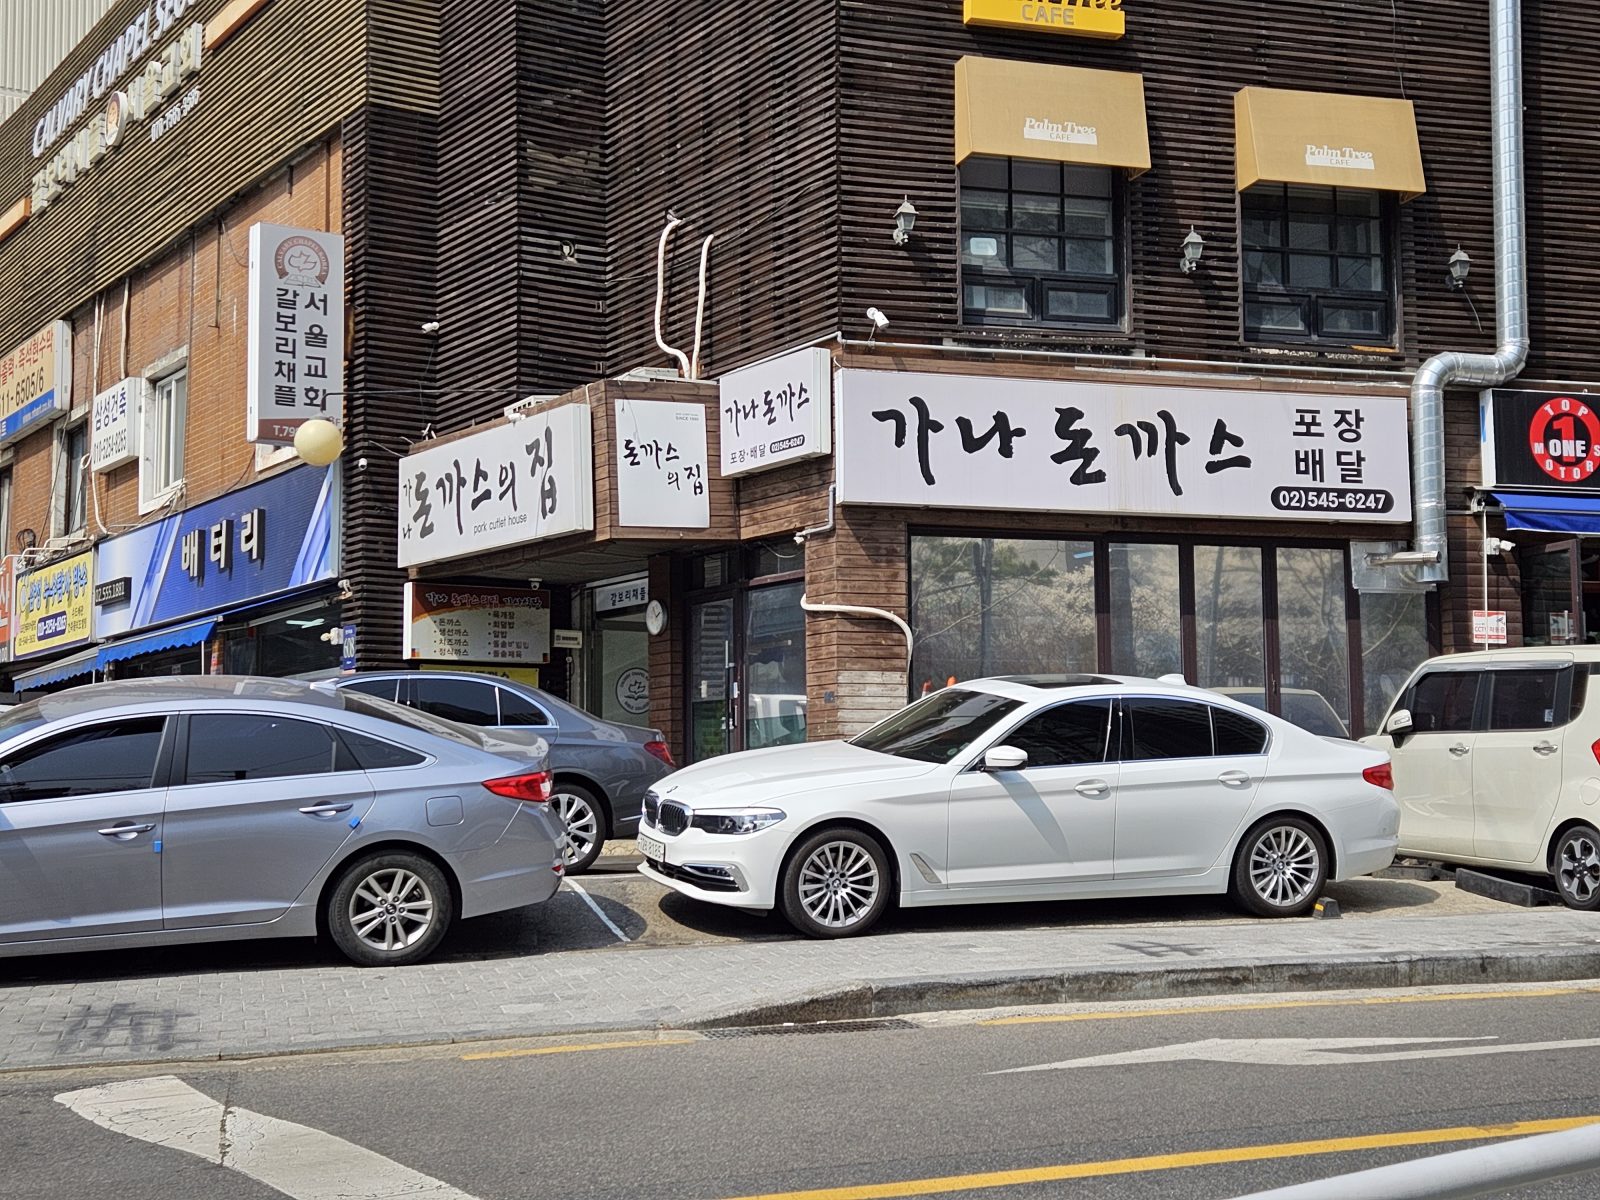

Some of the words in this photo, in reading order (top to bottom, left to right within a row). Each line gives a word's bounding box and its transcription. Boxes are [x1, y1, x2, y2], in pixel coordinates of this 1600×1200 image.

[1021, 4, 1075, 26] CAFE
[32, 66, 94, 158] CALVARY
[92, 8, 151, 99] CHAPEL
[1025, 117, 1062, 133] Palm
[1063, 121, 1097, 135] Tree
[1049, 132, 1072, 141] CAFE
[1305, 144, 1341, 158] Palm
[1342, 147, 1373, 159] Tree
[1329, 158, 1352, 167] CAFE
[274, 287, 300, 407] 갈보리채플
[303, 291, 328, 411] 서울교회
[95, 386, 127, 432] 삼성건축
[1544, 399, 1589, 417] TOP
[272, 424, 300, 437] T.79
[1292, 408, 1366, 444] 포장
[623, 438, 680, 470] 돈까스
[1548, 438, 1587, 458] ONE
[1294, 449, 1367, 486] 배달
[1279, 488, 1386, 512] 02)545-6247
[473, 522, 488, 536] pork
[489, 515, 507, 531] cutlet
[507, 512, 528, 526] house
[181, 508, 263, 578] 배터리
[426, 592, 448, 606] 가나
[439, 618, 462, 627] 돈까스
[439, 629, 469, 637] 생선까스
[439, 639, 469, 647] 치즈까스
[439, 649, 469, 657] 정식까스
